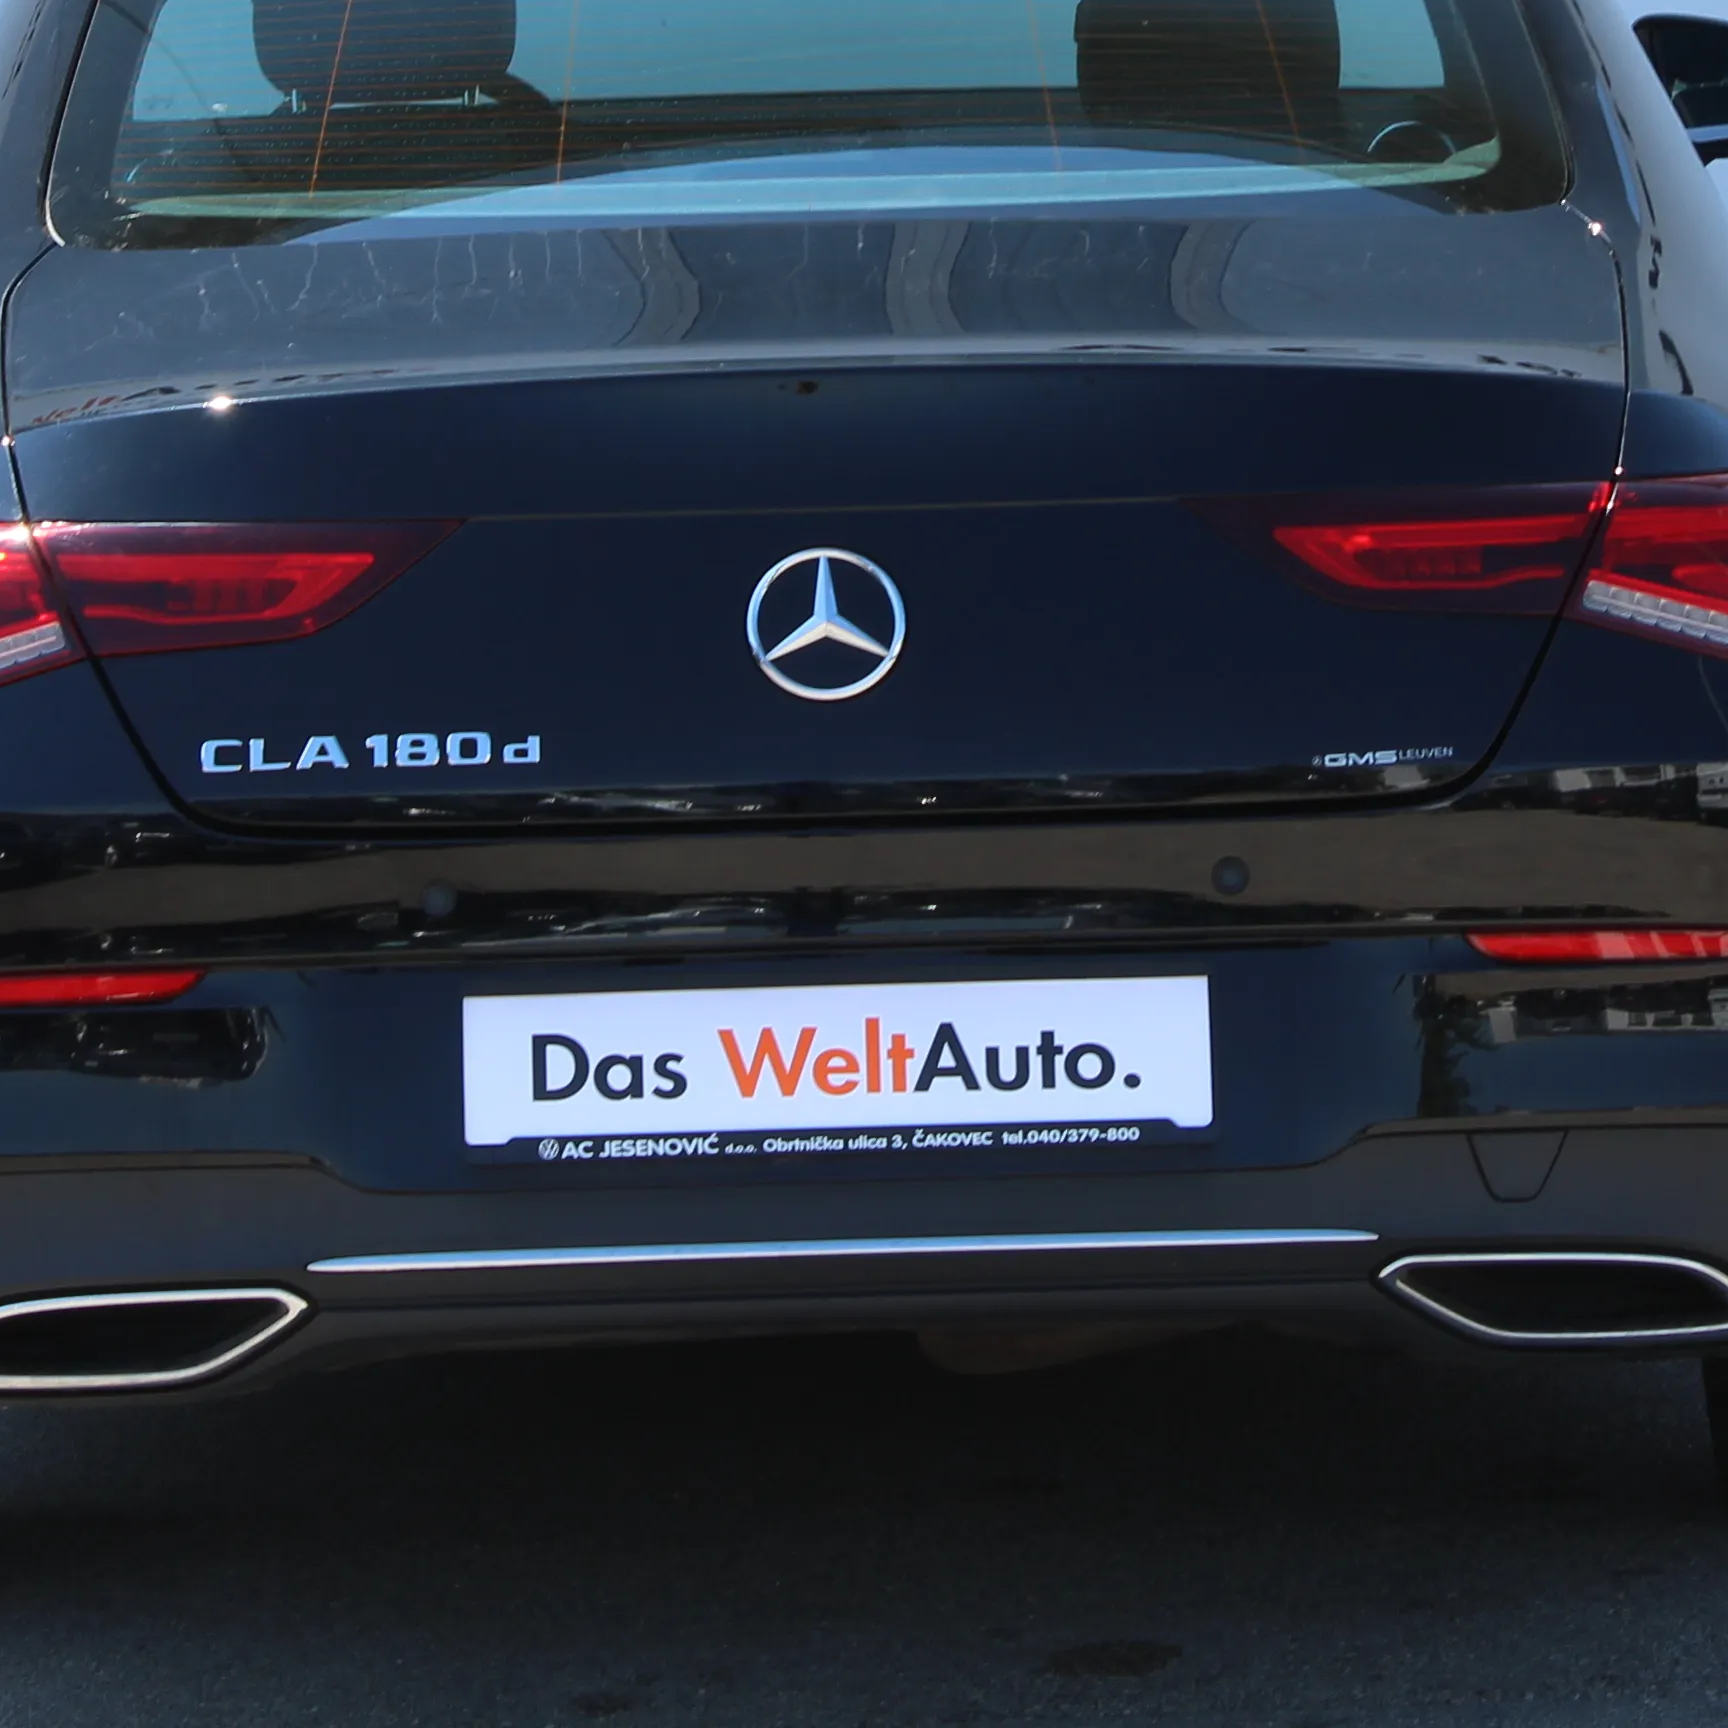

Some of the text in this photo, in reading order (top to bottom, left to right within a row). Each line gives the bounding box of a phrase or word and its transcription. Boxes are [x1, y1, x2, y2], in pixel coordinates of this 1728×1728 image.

[200, 736, 350, 773] CLA
[1324, 747, 1453, 767] GMS LEUVEN
[531, 1017, 1141, 1101] Das WeltAuto.
[561, 1140, 594, 1160] AC
[598, 1132, 720, 1158] JESENOVIĆ
[762, 1135, 844, 1154] Obrtnička
[848, 1134, 888, 1151] ulica
[912, 1128, 994, 1148] ČAKOVEC
[1001, 1126, 1141, 1146] tel.040/379-800
